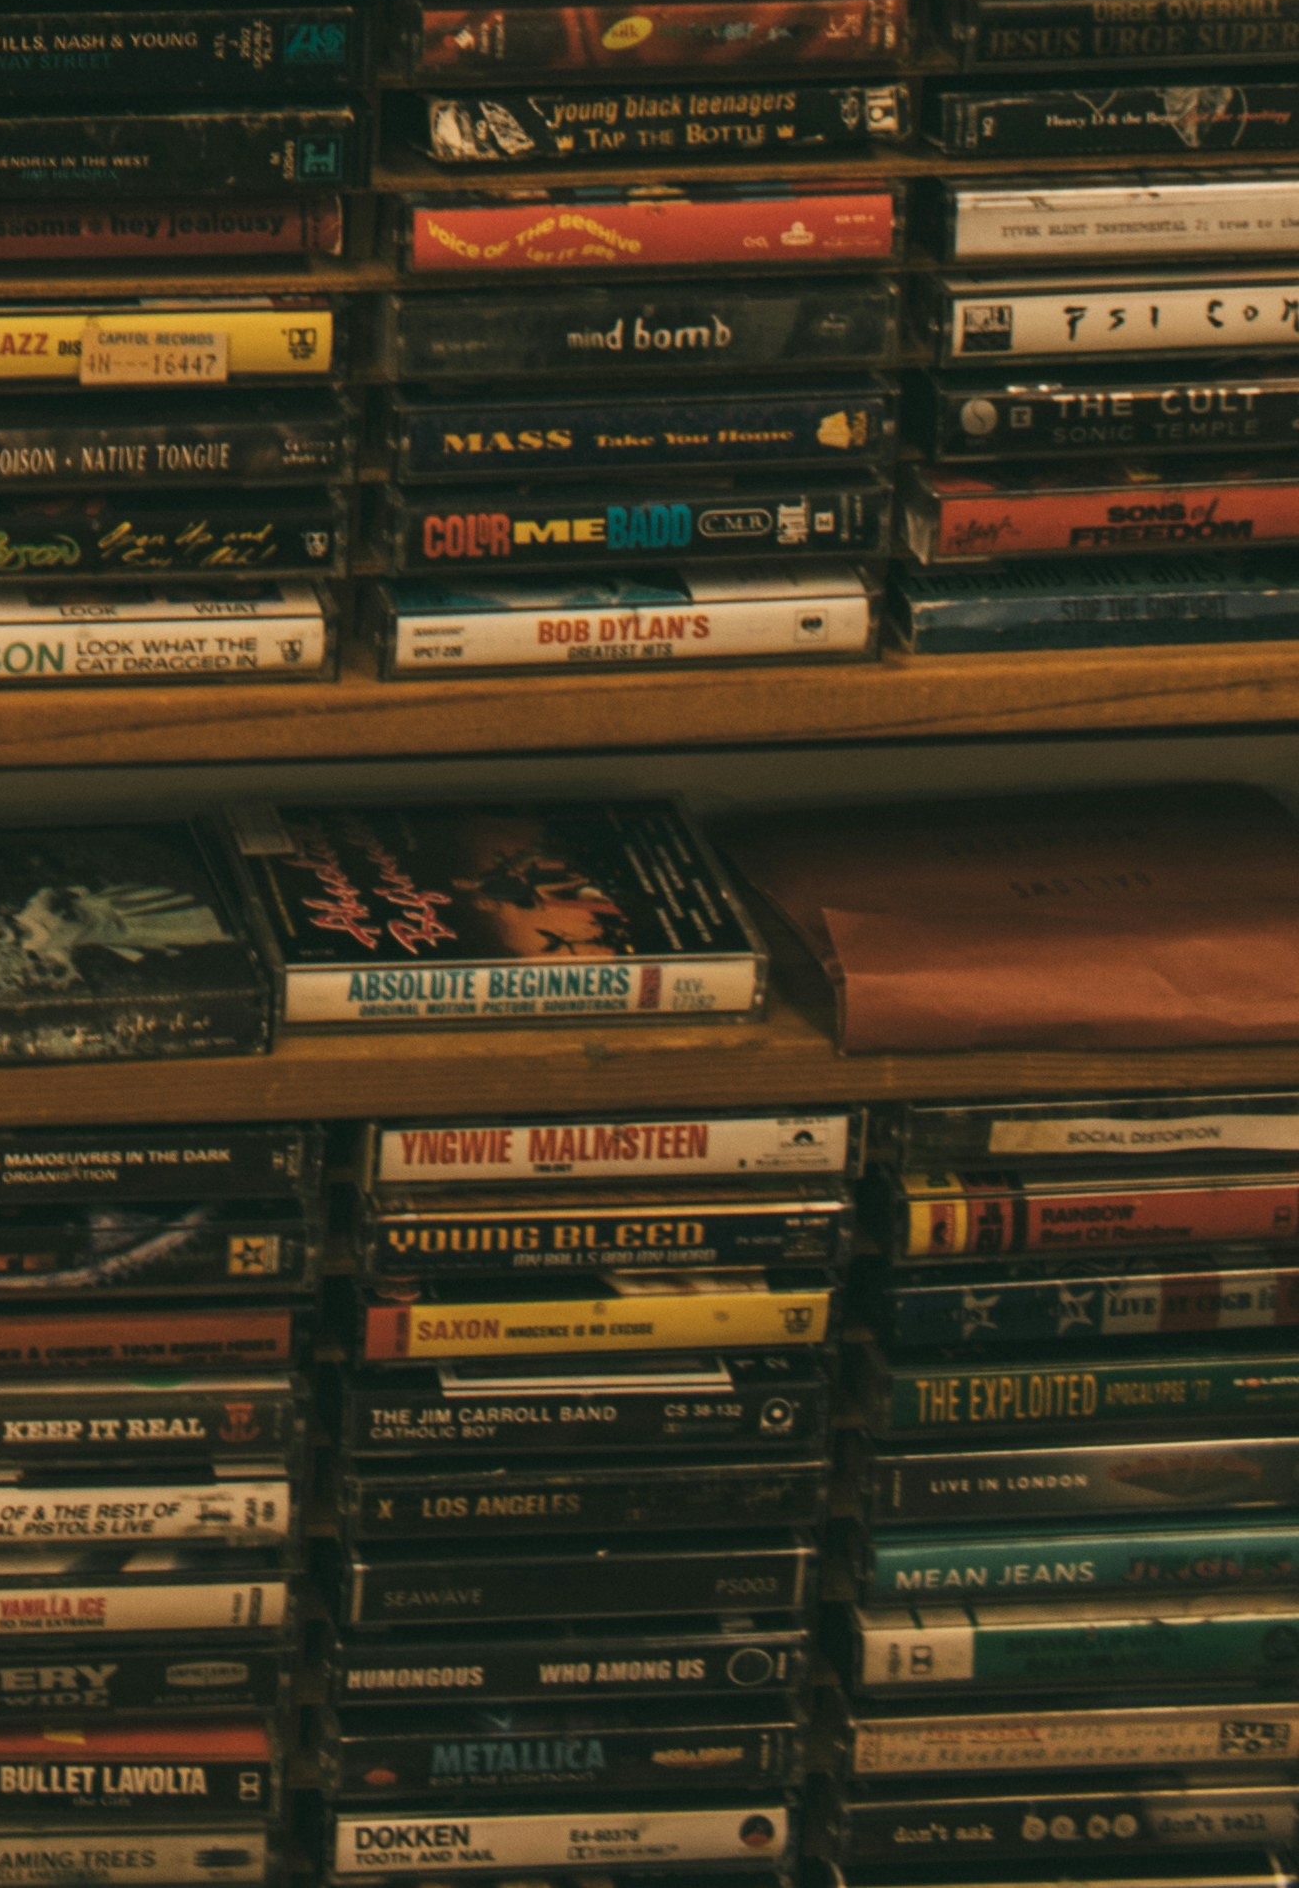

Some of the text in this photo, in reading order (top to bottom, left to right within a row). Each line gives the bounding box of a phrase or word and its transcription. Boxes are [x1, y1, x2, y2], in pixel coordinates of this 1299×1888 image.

[349, 967, 630, 1001] ABSOLUTE BEGINNERS
[401, 1125, 709, 1166] YNGWIE MALMSTEEN
[3, 1418, 204, 1442] KEEP IT REAL
[894, 1561, 1095, 1589] MEAN JEANS
